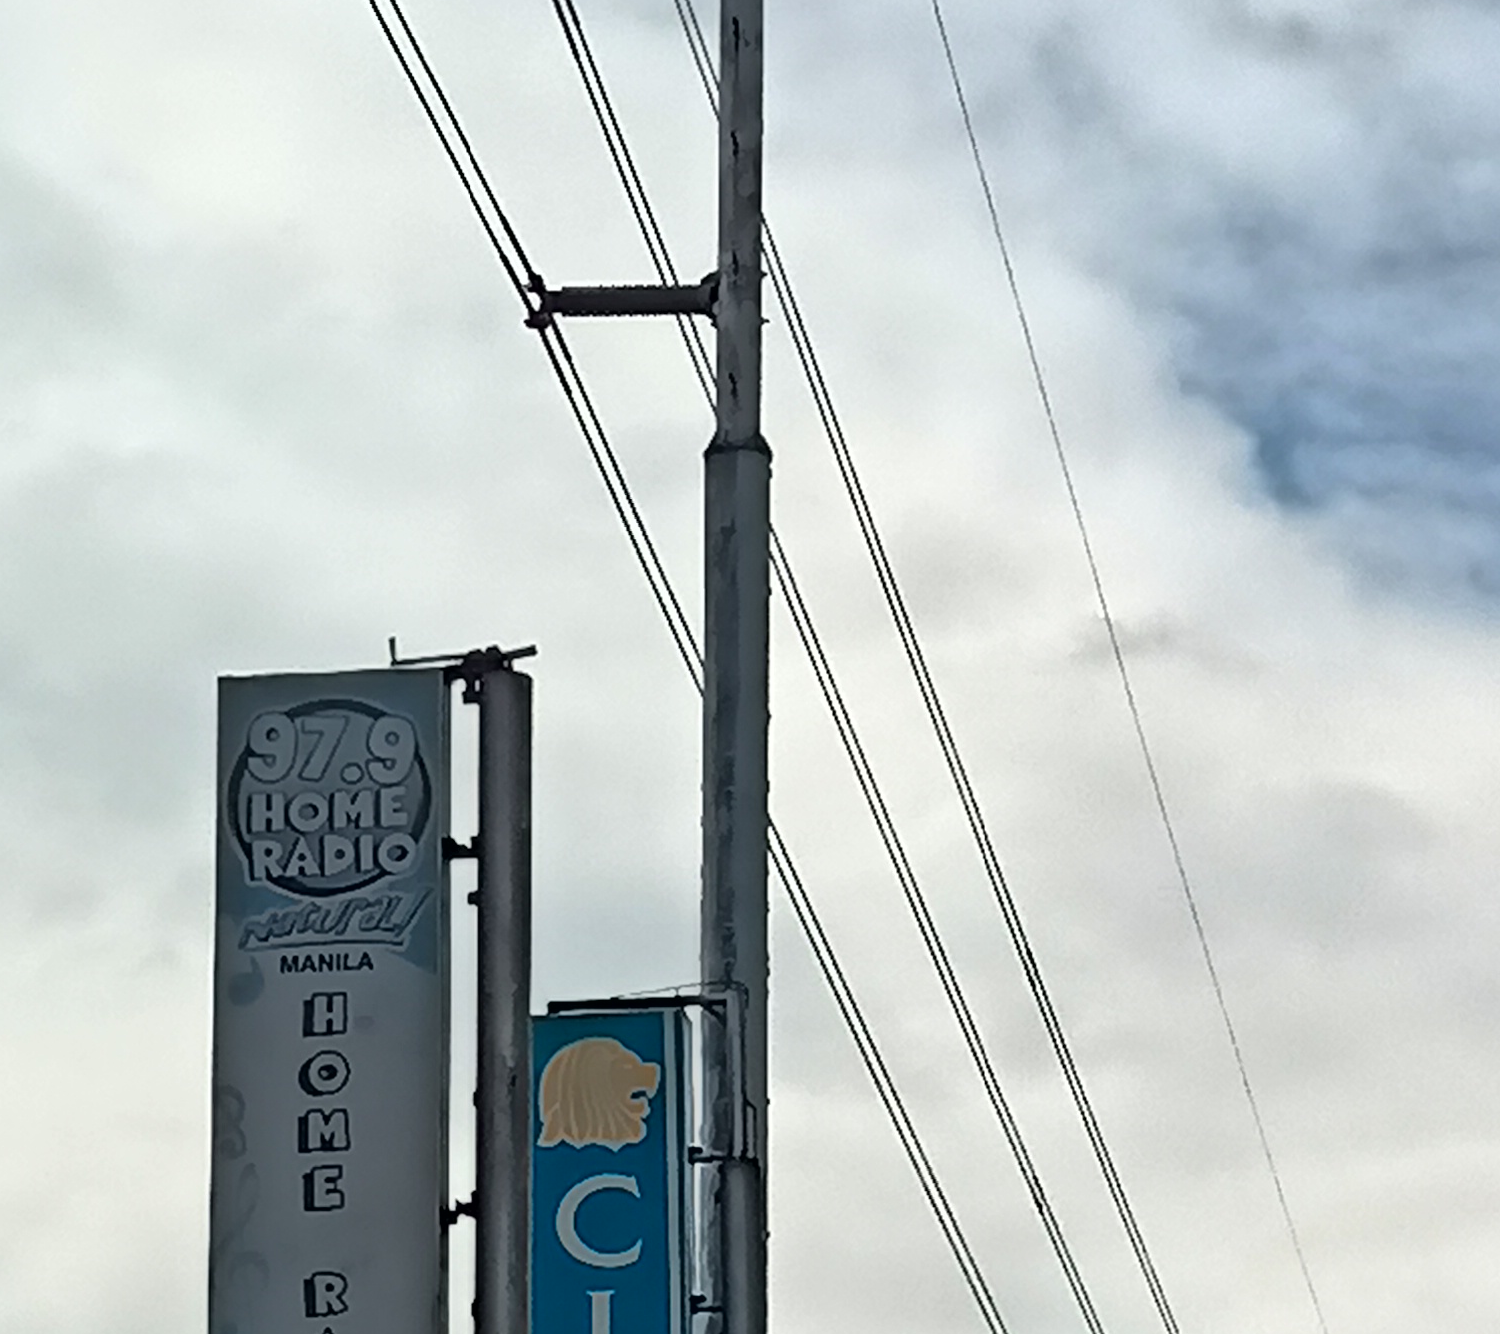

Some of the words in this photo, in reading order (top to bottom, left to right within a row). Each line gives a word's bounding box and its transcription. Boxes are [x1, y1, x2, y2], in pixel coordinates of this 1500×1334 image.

[247, 711, 417, 786] 97.9
[247, 786, 408, 835] HOME
[251, 832, 416, 880] RADIO
[280, 952, 374, 974] MANILA
[298, 992, 351, 1211] HOME
